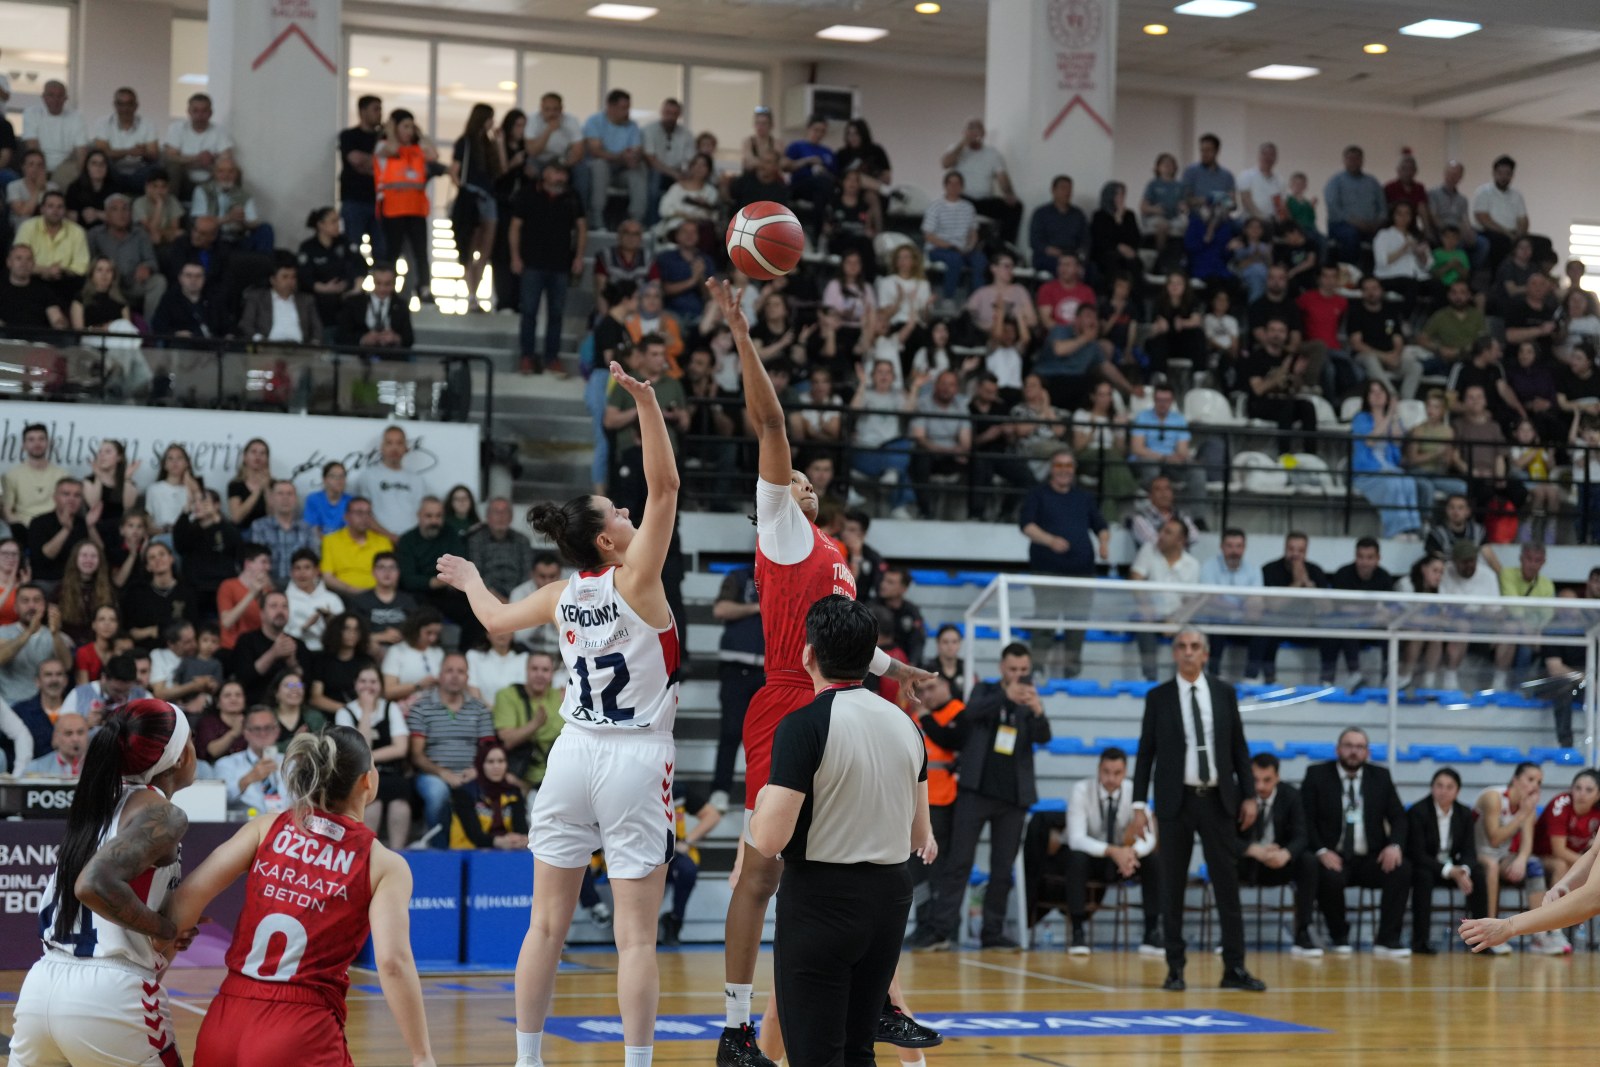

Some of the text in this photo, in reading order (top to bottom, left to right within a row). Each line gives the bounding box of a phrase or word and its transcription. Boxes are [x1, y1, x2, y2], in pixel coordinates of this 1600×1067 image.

[573, 652, 635, 721] 12
[272, 824, 356, 874] ÖZCAN
[253, 859, 348, 901] KARAATA
[263, 884, 326, 912] BETON
[241, 913, 308, 982] 0
